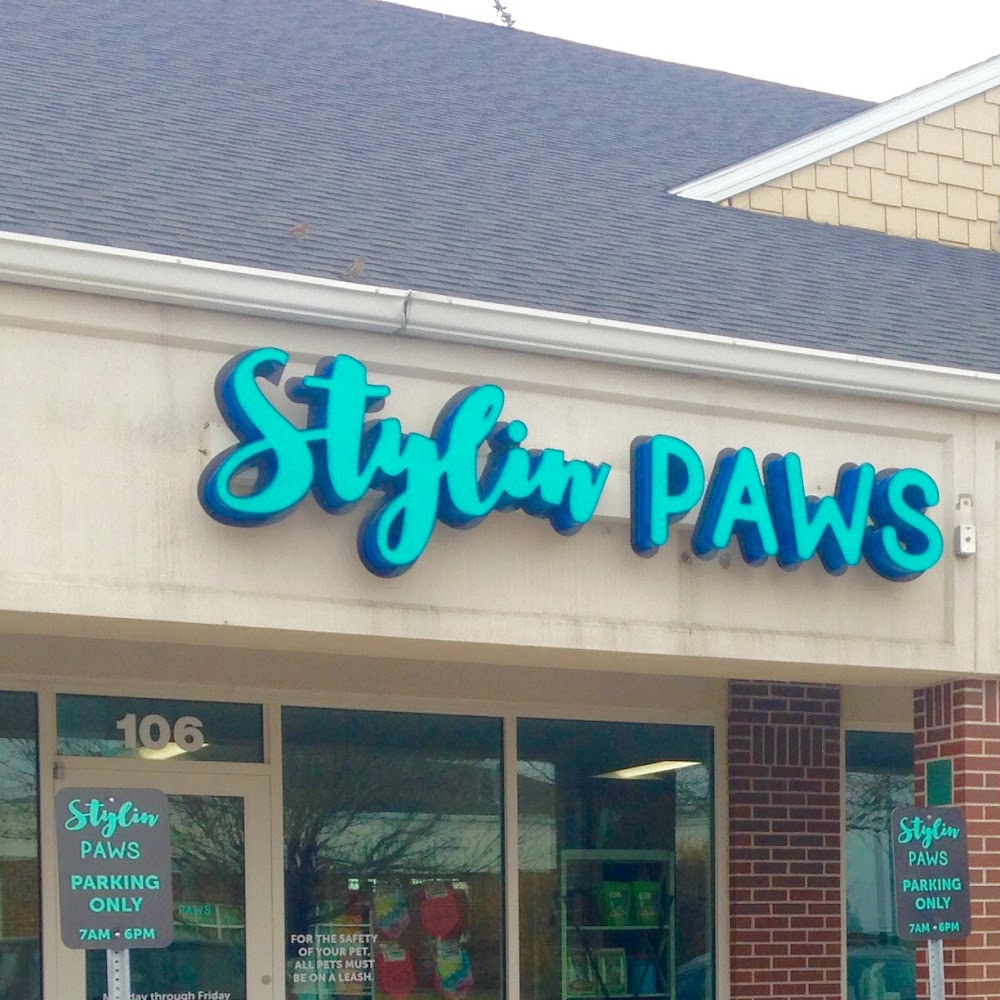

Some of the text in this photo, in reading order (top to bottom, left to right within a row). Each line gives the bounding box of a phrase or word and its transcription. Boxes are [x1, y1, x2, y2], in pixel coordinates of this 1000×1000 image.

[203, 347, 943, 579] Stylin PAWS
[116, 713, 205, 752] 106
[65, 799, 159, 838] Stylin
[897, 817, 960, 849] Stylin
[81, 841, 141, 859] PAWS
[908, 851, 949, 866] PAWS
[71, 875, 160, 890] PARKING
[902, 878, 962, 892] PARKING
[89, 897, 143, 912] ONLY
[915, 897, 951, 910] ONLY
[79, 928, 155, 940] 7AM 6PM
[909, 922, 960, 933] 7AM 6PM
[290, 933, 378, 944] FOR THE SAFETY
[298, 947, 371, 957] OF YOUR PET,
[294, 959, 375, 970] ALL PETS MUST
[293, 972, 375, 983] BE ON A LEASH.
